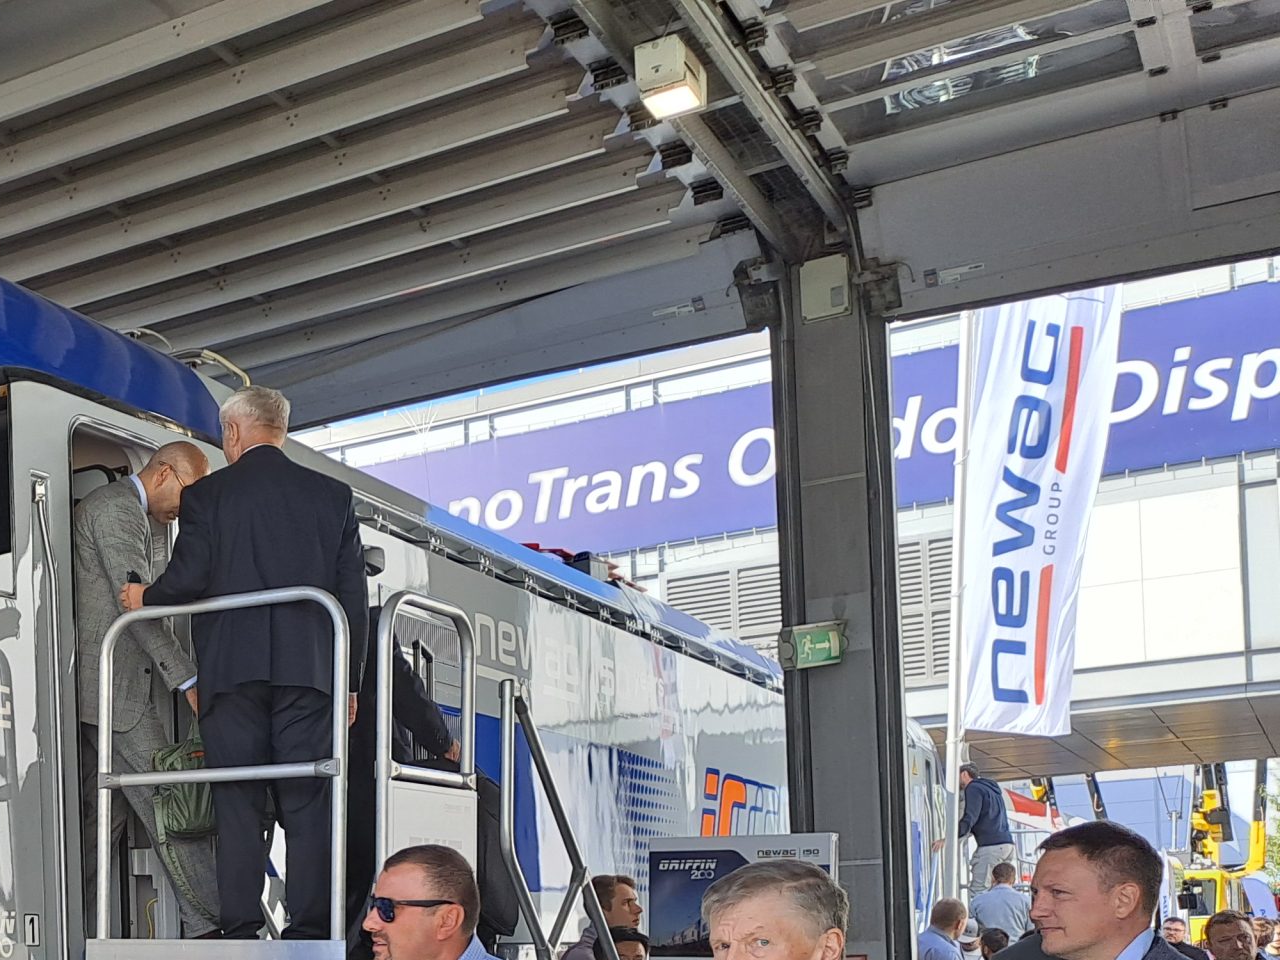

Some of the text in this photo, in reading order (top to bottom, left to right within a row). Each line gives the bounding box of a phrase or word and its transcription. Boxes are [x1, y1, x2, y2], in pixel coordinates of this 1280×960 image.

[1042, 481, 1065, 556] GROUP
[658, 858, 718, 871] GRIFFIN
[690, 869, 716, 880] 200
